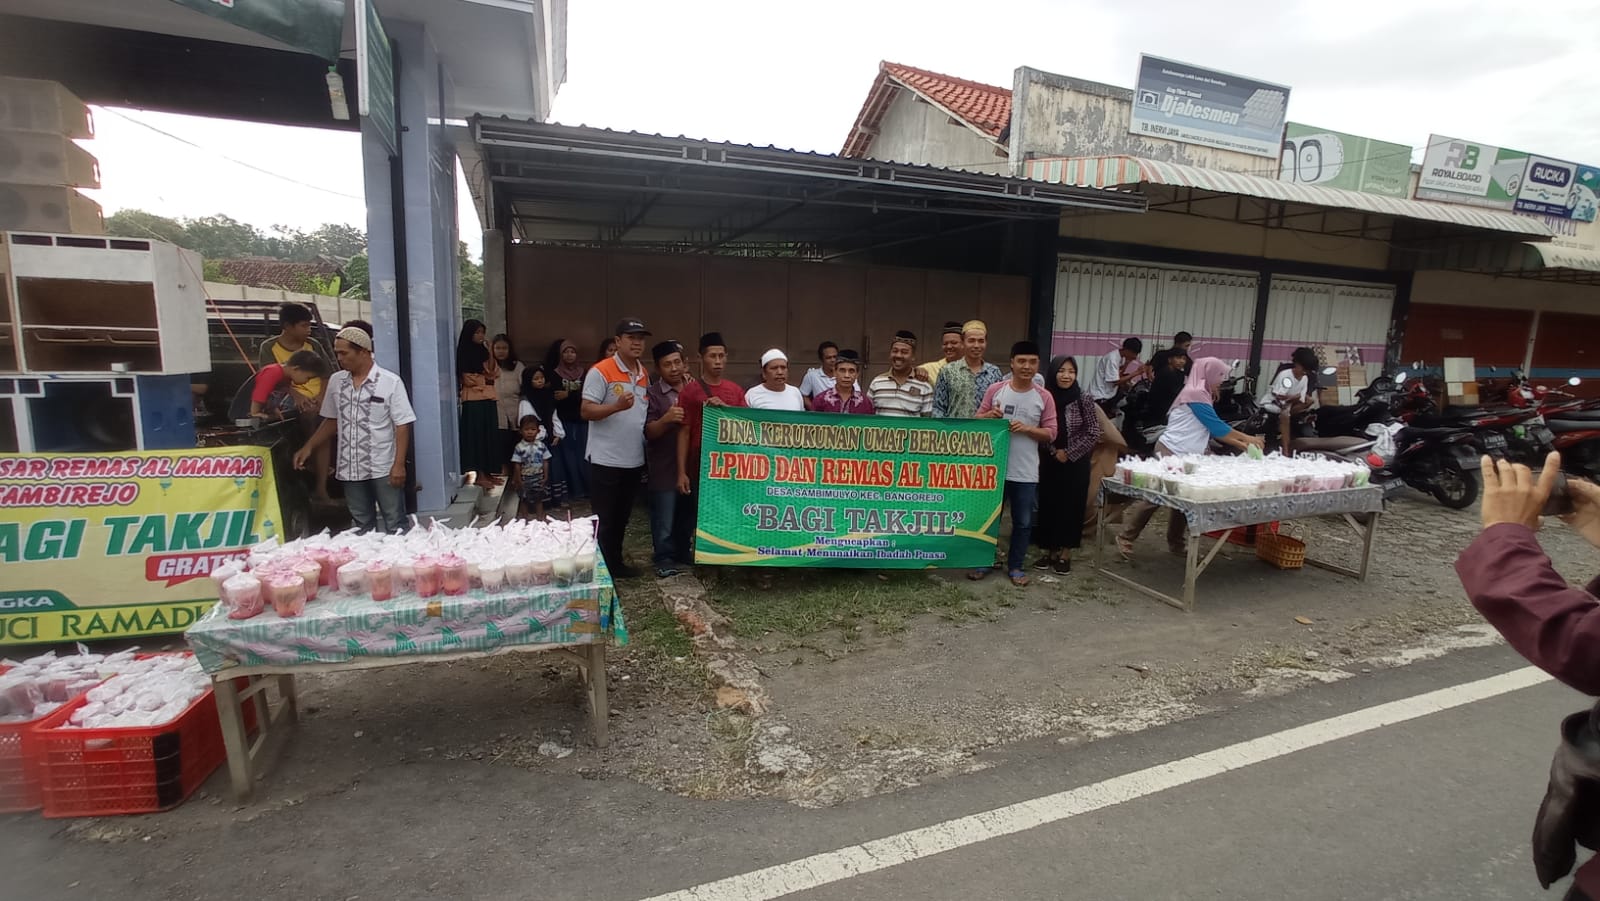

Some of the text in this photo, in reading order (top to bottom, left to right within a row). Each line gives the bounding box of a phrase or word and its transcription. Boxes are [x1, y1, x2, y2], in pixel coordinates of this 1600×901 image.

[1160, 94, 1240, 126] Djabesmen
[1431, 168, 1482, 183] ROYALBOARD
[1534, 167, 1565, 183] RUCIKA
[718, 418, 994, 457] BINA KERUKUNAN UMAT BERAGAMA
[51, 456, 139, 480] REMAS
[138, 456, 172, 478] AL
[172, 456, 264, 479] MANAAR
[708, 452, 998, 491] LPMD DAN REMAS AL MANAR
[0, 482, 139, 507] AMBIREJO
[766, 486, 945, 502] DESA SAMBIMULYO KEC. BANGOREJO
[104, 509, 259, 556] TAKJIL
[814, 536, 889, 549] Mengucapkan
[757, 546, 803, 557] Selamat
[875, 549, 912, 559] Ibadah
[914, 550, 947, 560] Puasa
[157, 553, 247, 578] GRAT
[0, 616, 39, 640] CI
